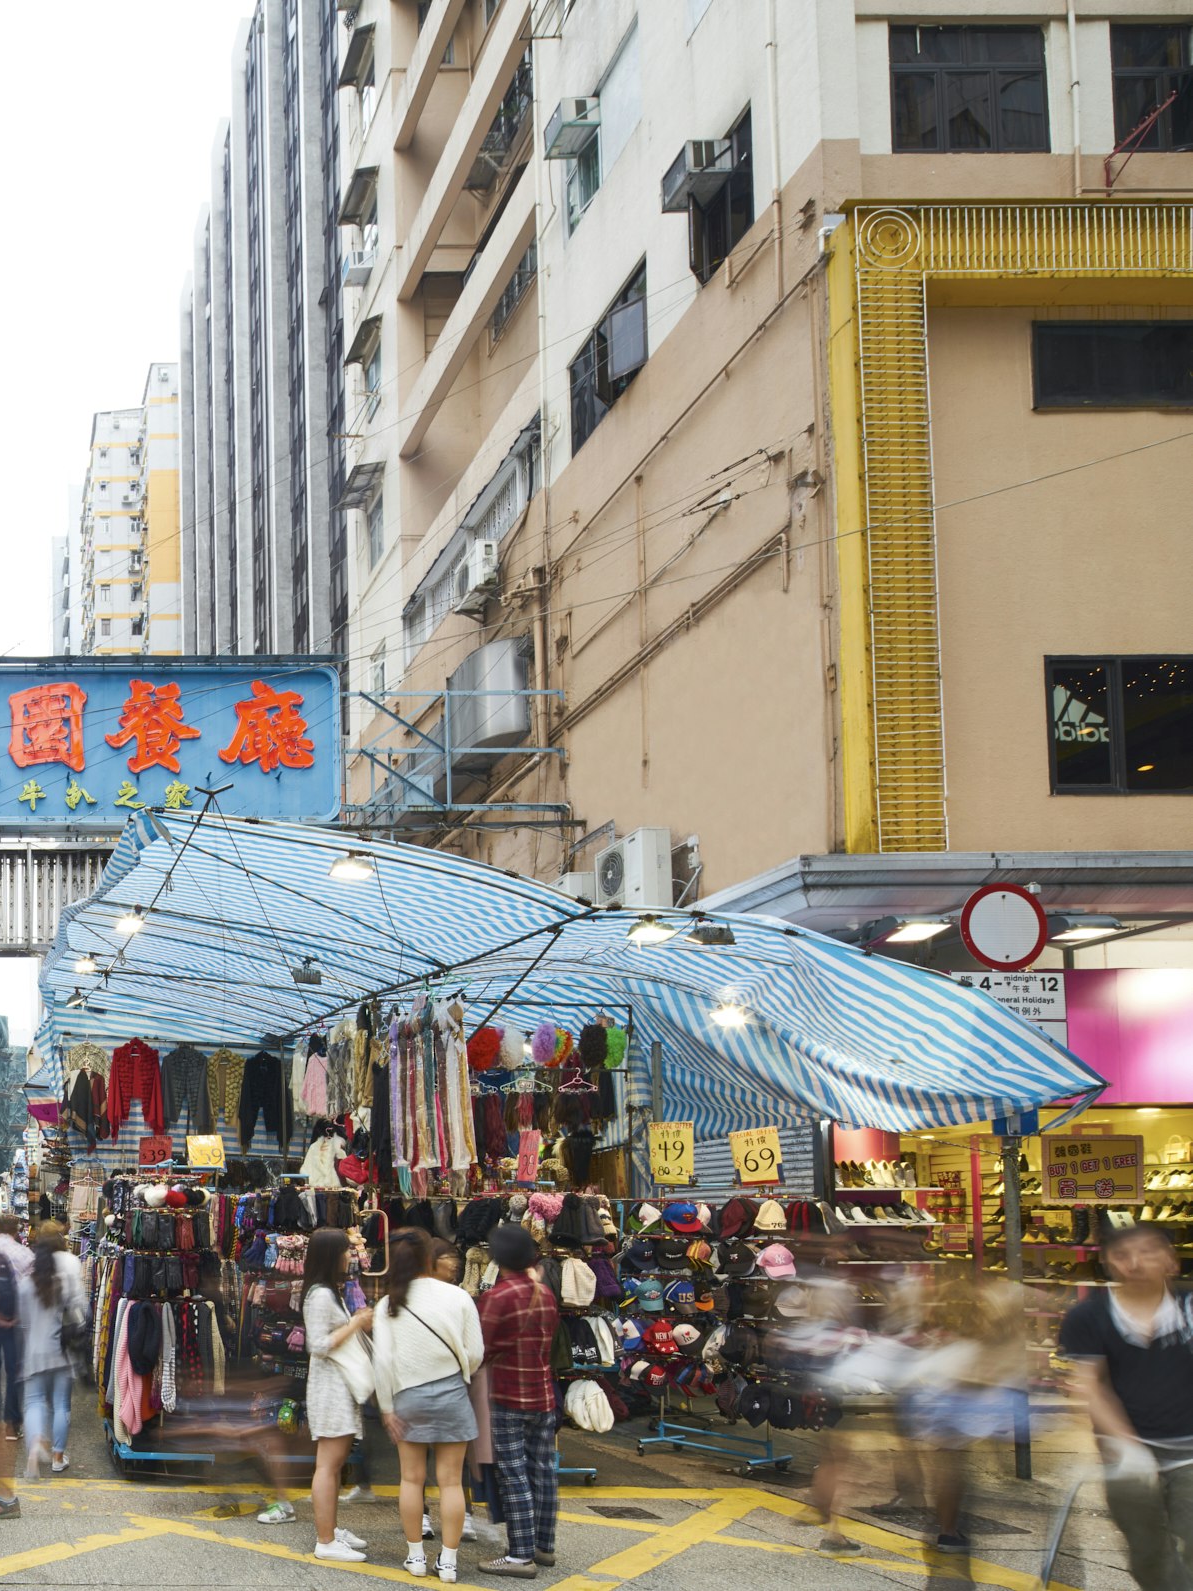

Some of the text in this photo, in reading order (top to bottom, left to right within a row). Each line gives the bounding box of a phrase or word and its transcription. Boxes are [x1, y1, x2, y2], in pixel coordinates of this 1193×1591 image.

[979, 976, 992, 991] 4
[1003, 974, 1037, 983] midnight
[1039, 977, 1059, 992] 12
[1012, 985, 1031, 993] 午夜
[1022, 996, 1055, 1004] Holidays
[1048, 1154, 1138, 1177] BUY 1 GET 1 FREE
[1058, 1178, 1133, 1198] 買一送一
